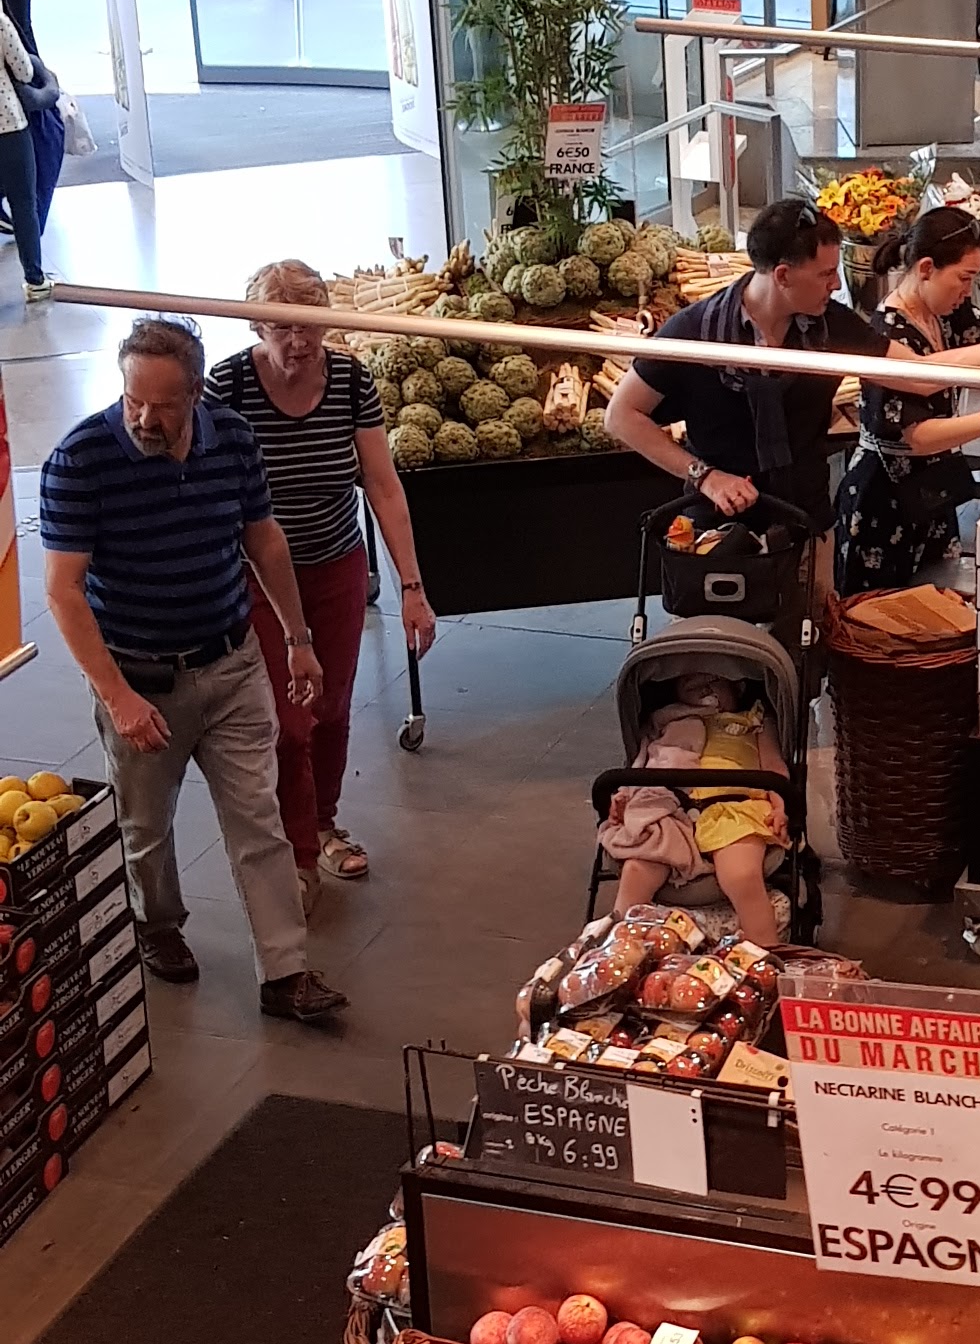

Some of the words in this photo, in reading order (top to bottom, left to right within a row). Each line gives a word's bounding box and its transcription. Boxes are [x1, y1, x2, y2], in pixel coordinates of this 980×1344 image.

[557, 146, 590, 158] 6€50
[550, 163, 595, 174] FRANCE
[30, 832, 65, 866] NOUVEAU
[795, 1005, 825, 1031] LA
[829, 1008, 905, 1037] BONNE
[800, 1035, 841, 1064] DU
[814, 1080, 906, 1103] NECTARINE
[524, 1103, 627, 1137] ESPAGNE
[892, 1148, 944, 1163] kilogramme
[902, 1218, 937, 1230] Origine
